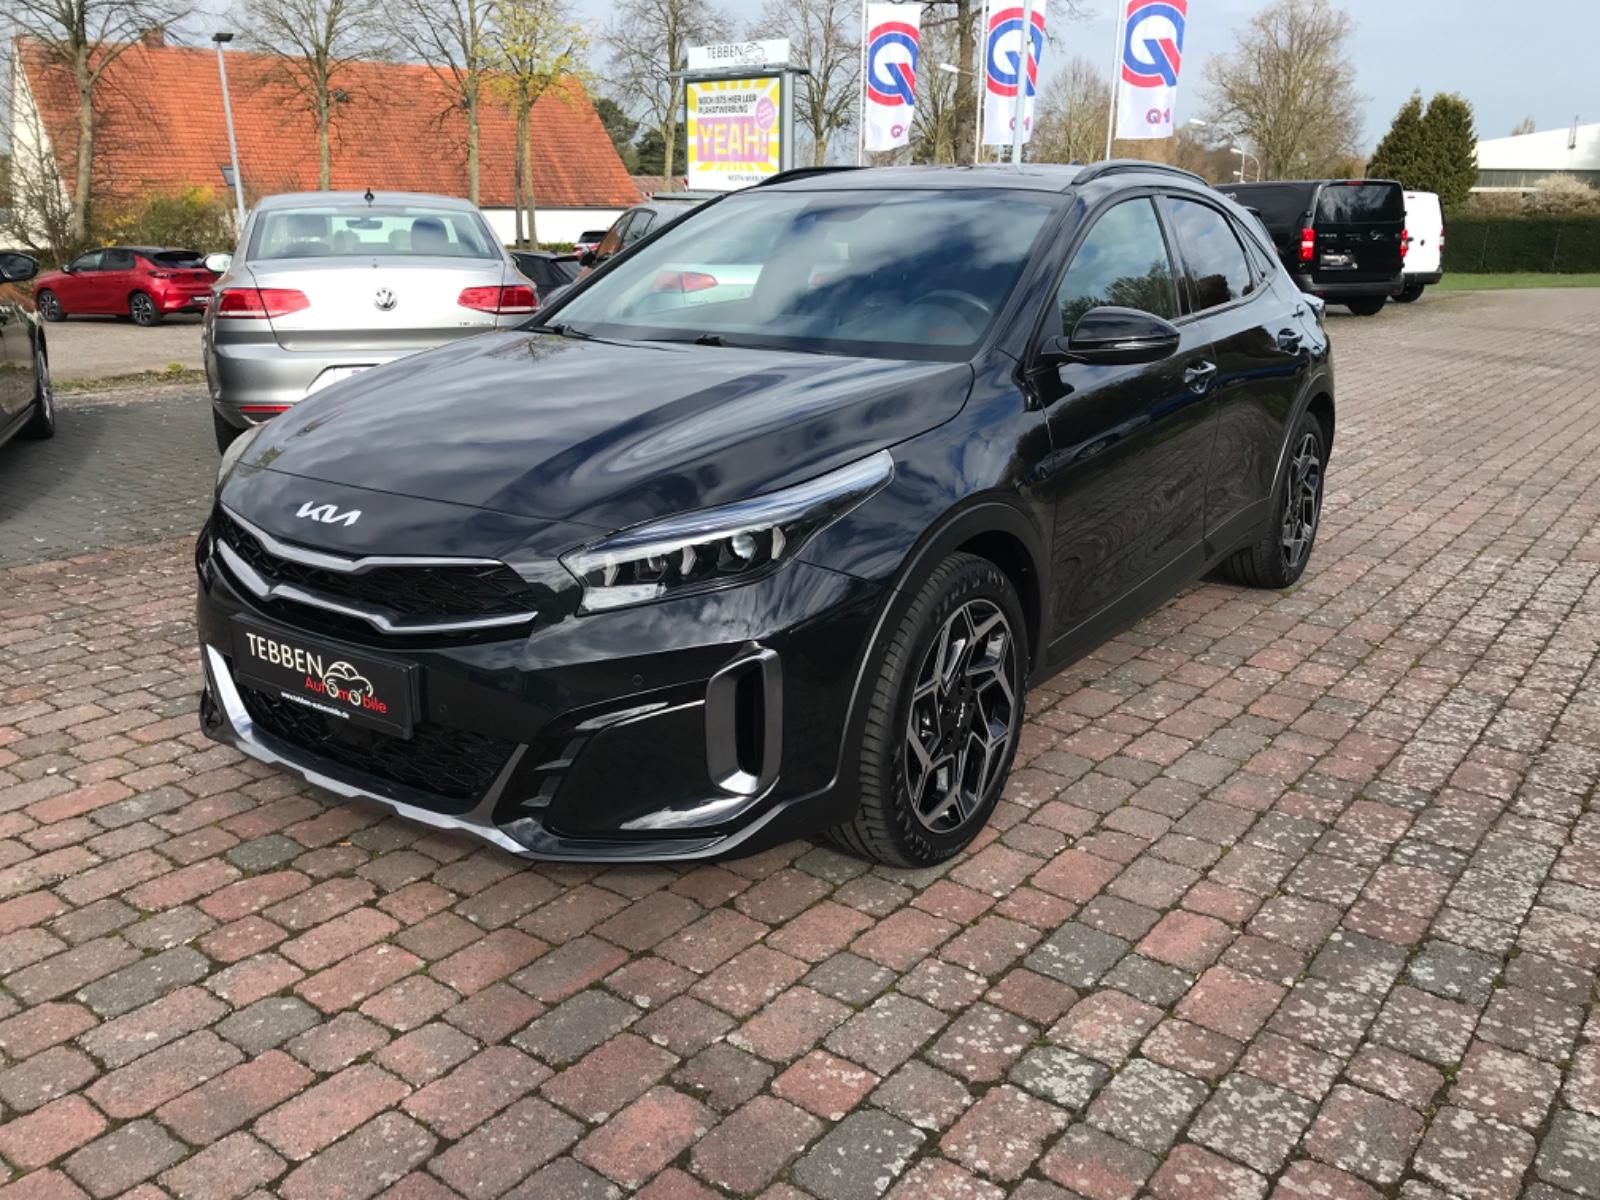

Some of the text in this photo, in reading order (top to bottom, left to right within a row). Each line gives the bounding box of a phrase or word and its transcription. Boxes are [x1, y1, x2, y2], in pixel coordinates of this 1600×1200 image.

[707, 45, 743, 59] TEBBEN
[296, 500, 362, 527] KIA
[246, 632, 323, 679] TEBBEN
